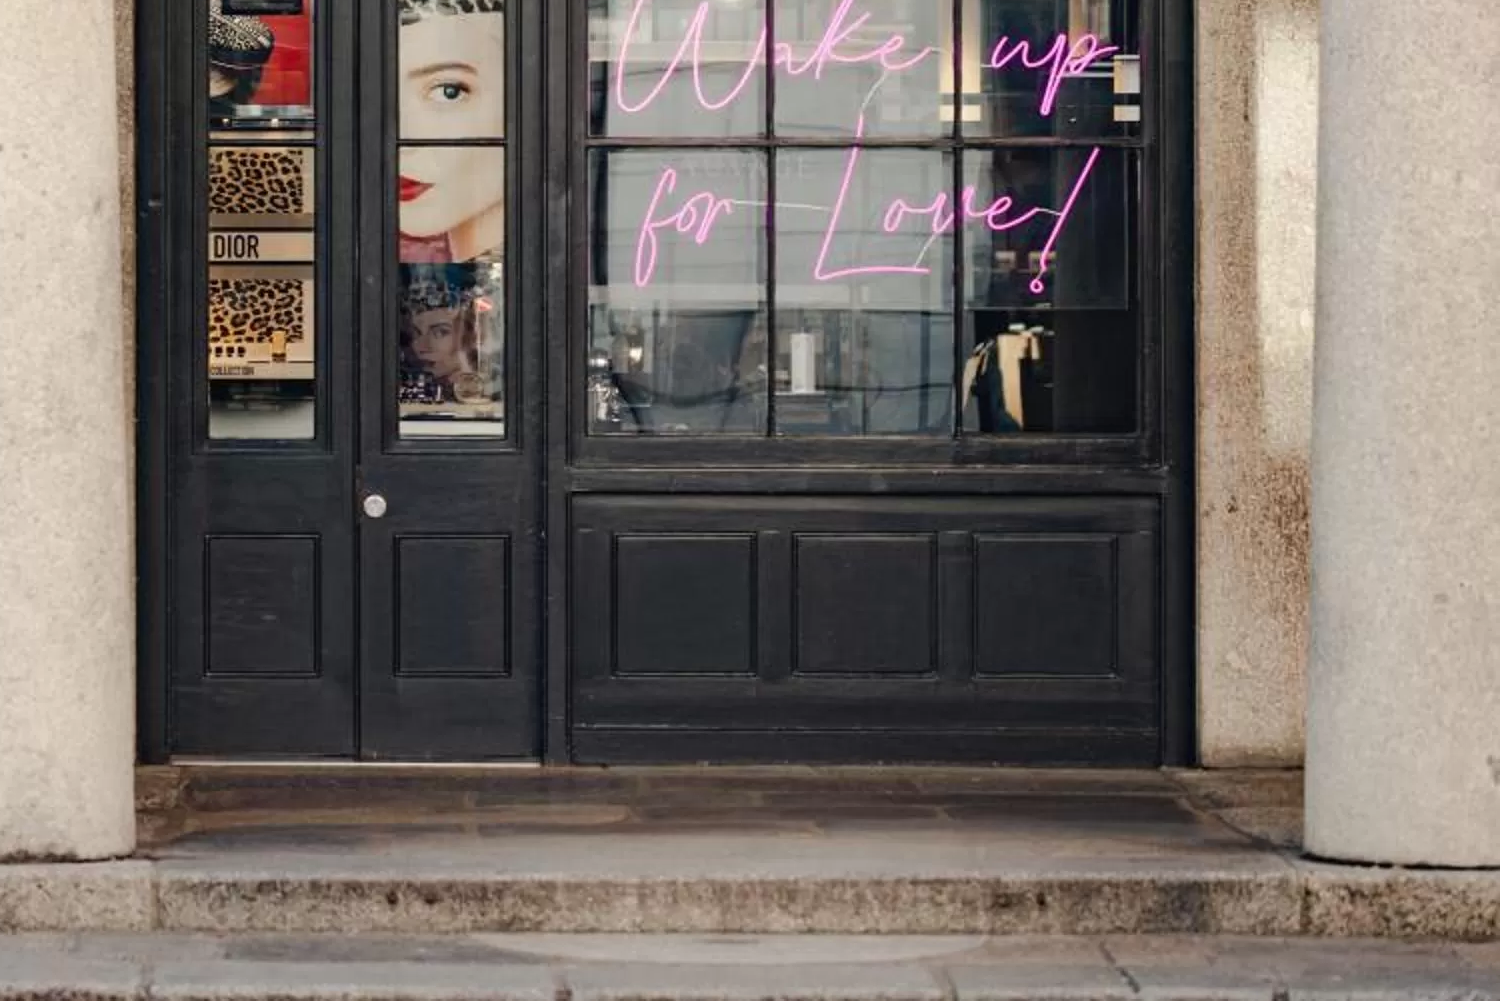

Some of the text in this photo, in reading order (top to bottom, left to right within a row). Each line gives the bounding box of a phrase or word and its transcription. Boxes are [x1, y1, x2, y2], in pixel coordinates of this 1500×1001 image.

[988, 33, 1119, 116] up
[635, 111, 1101, 294] for Love!
[213, 234, 260, 259] DIOR
